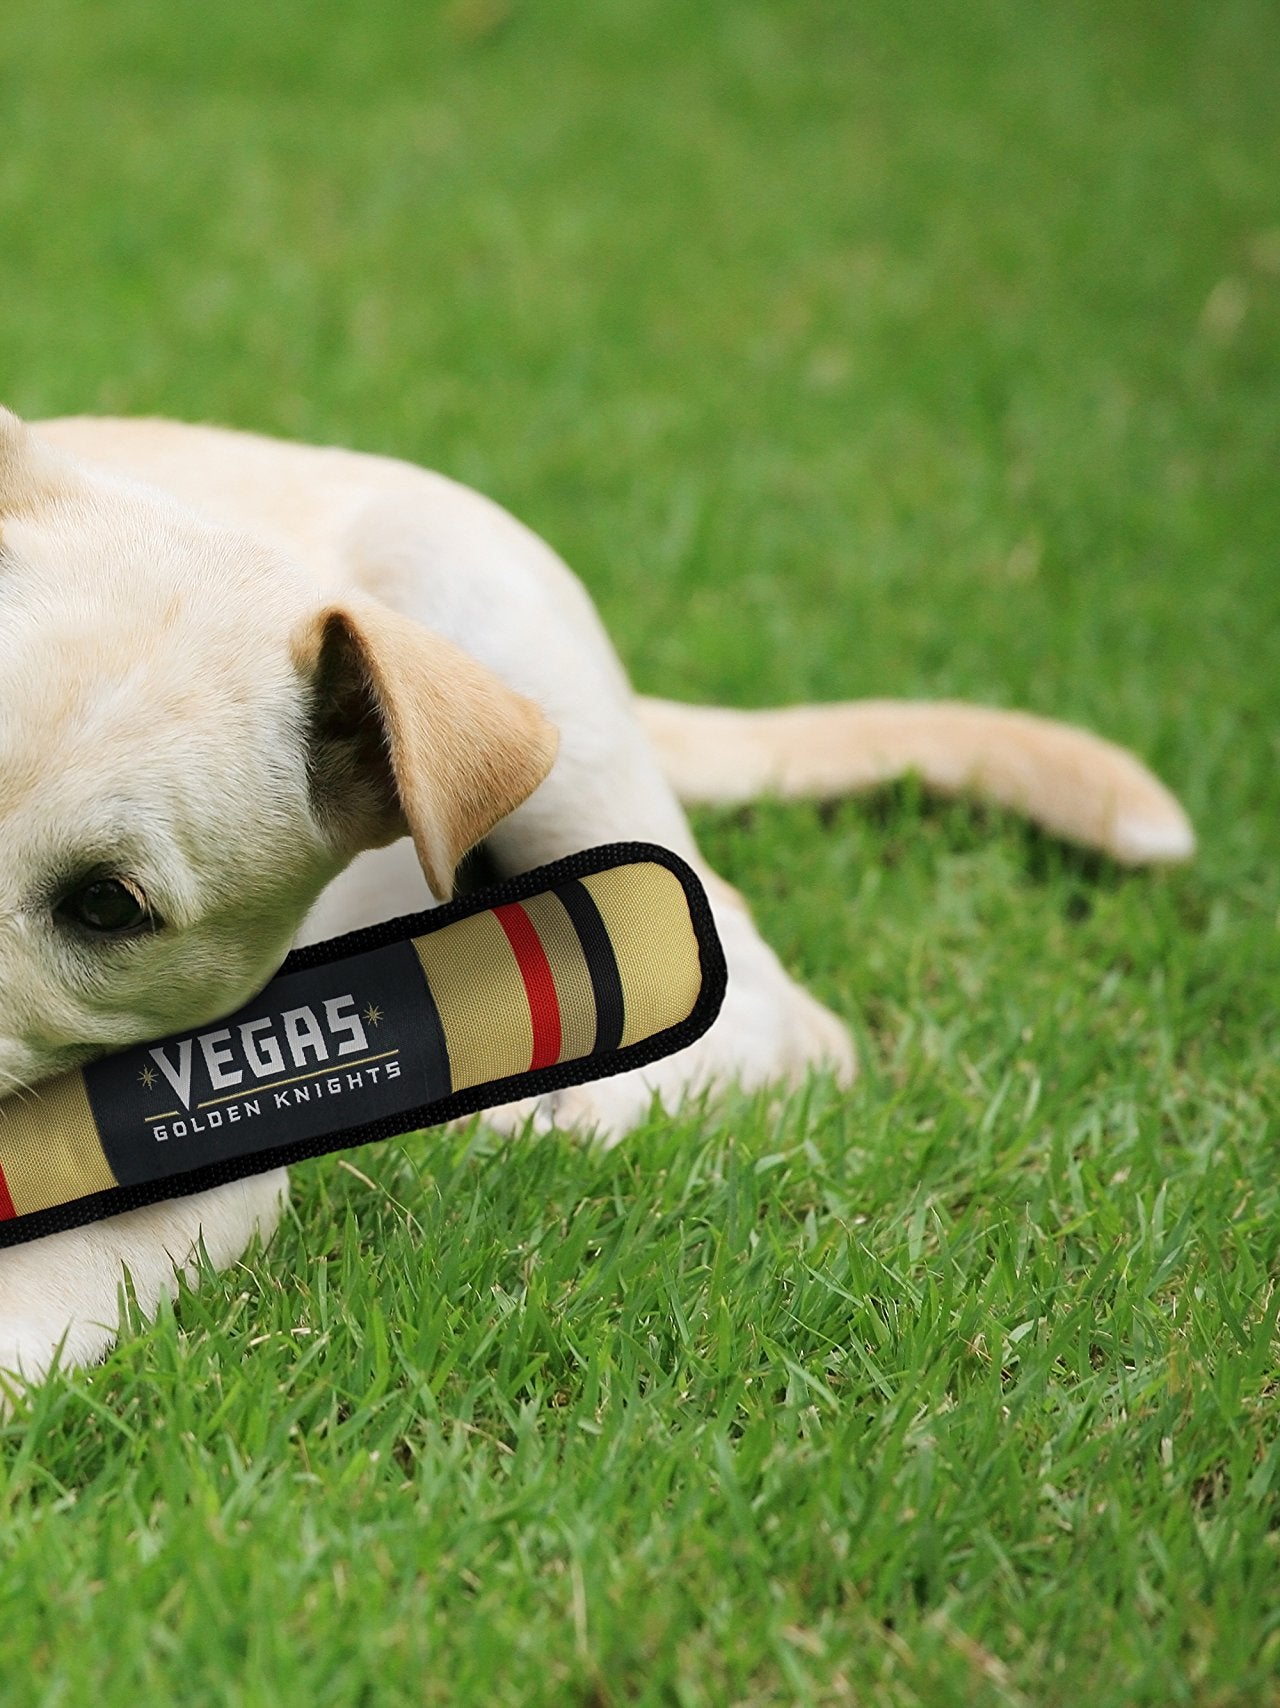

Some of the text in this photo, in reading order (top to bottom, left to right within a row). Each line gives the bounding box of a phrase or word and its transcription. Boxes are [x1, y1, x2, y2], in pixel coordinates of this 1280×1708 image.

[148, 994, 369, 1111] VEGAS
[153, 1061, 401, 1142] GOLDEN KNIGHTS
